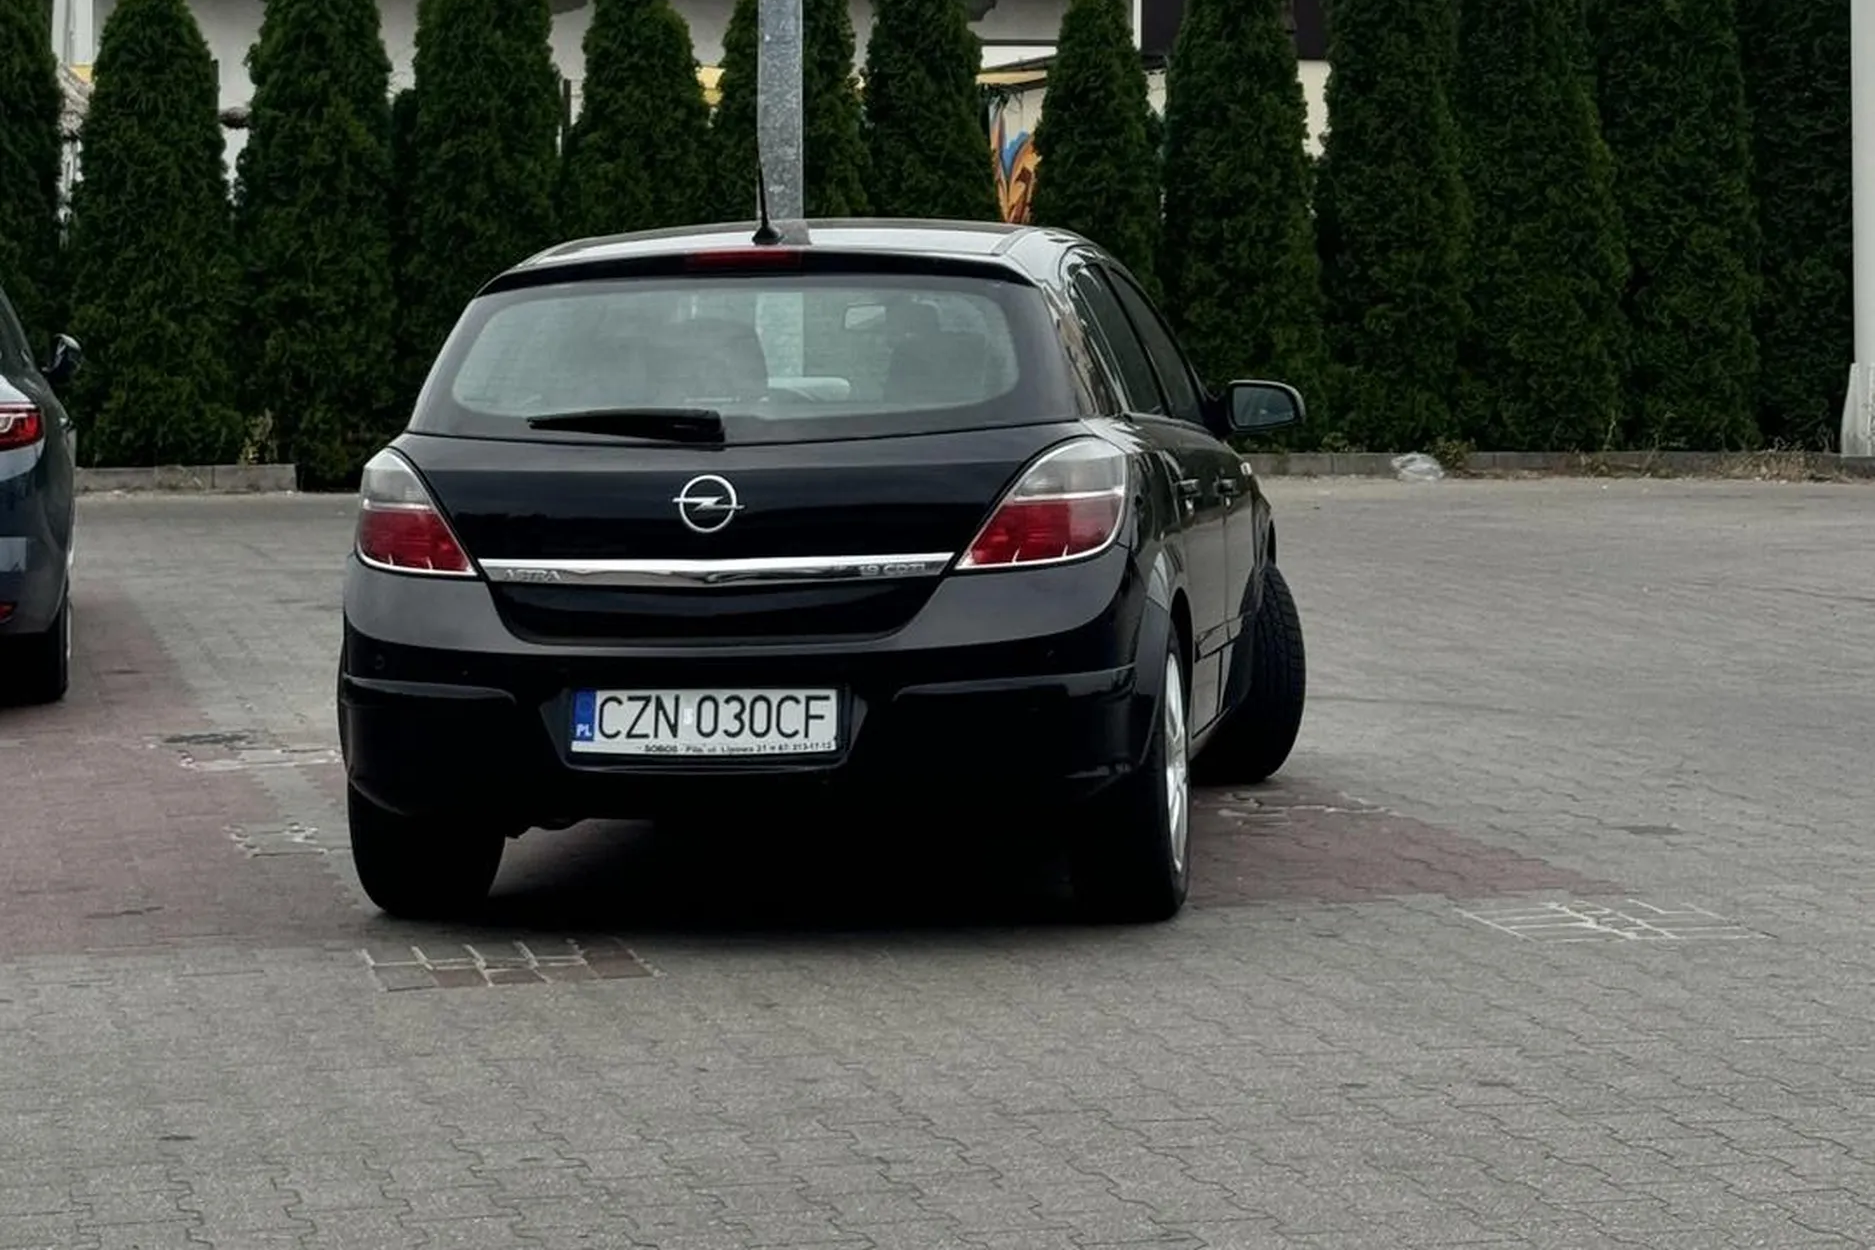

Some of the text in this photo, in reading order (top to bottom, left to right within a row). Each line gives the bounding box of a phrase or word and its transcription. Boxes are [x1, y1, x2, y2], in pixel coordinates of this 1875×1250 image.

[575, 723, 593, 738] PL
[599, 694, 831, 739] CZN 030CF
